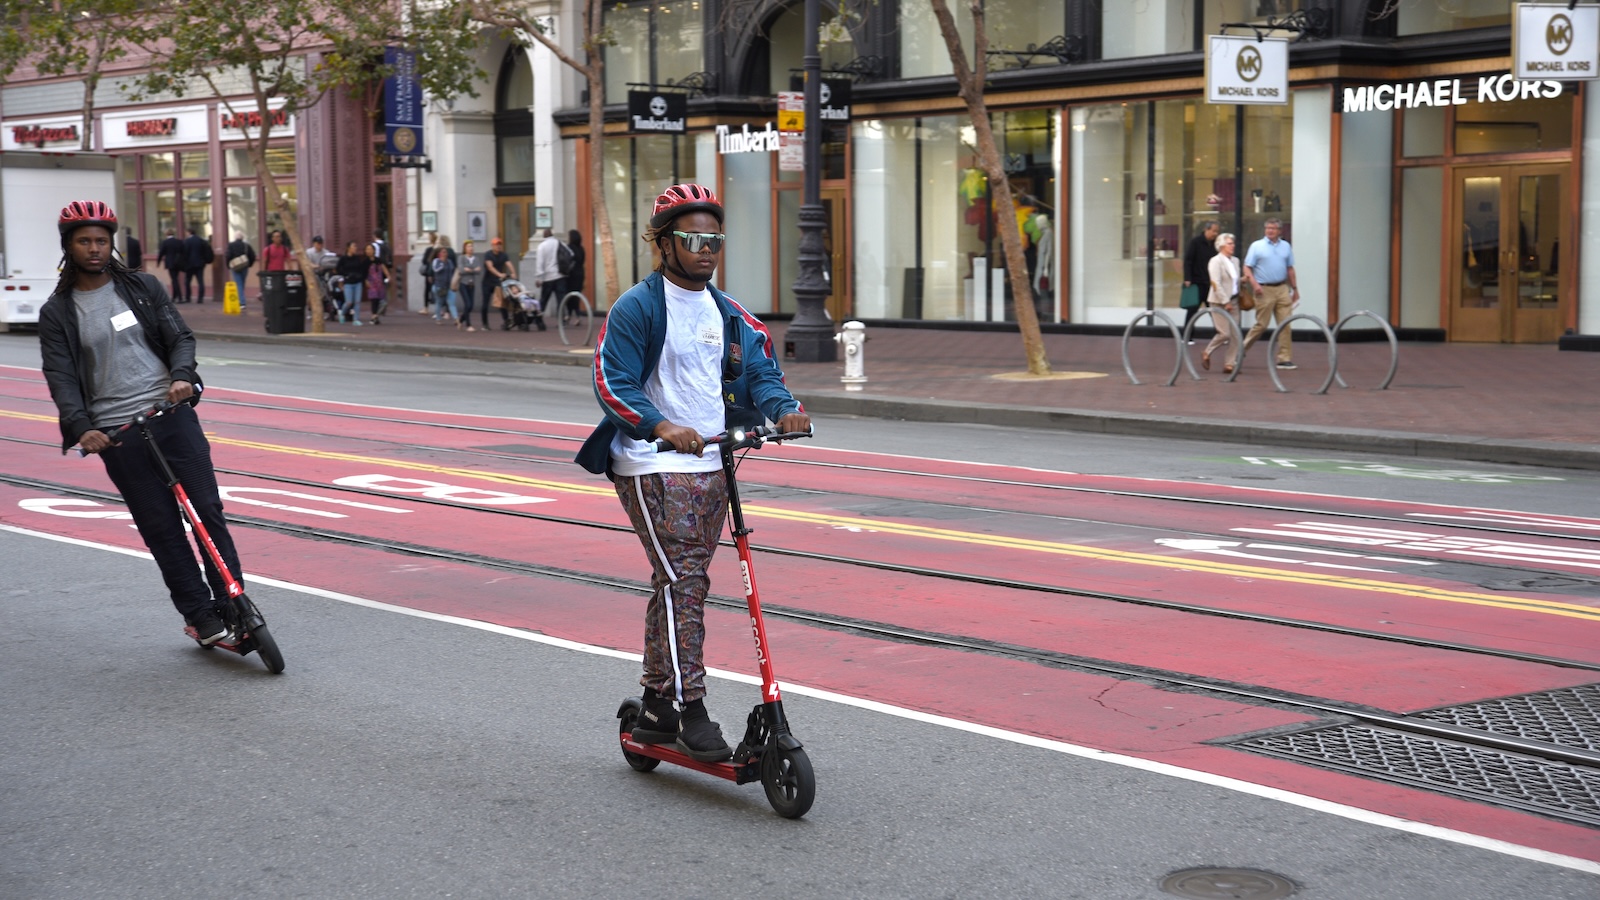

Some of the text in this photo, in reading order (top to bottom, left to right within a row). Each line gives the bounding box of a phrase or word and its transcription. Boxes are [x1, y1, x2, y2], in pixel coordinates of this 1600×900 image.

[1526, 61, 1591, 72] MICHAEL KORS
[1218, 86, 1279, 97] MICHAEL KORS
[1343, 73, 1562, 113] MICHAEL KORS
[395, 104, 404, 121] SAN
[632, 115, 684, 131] Timberland
